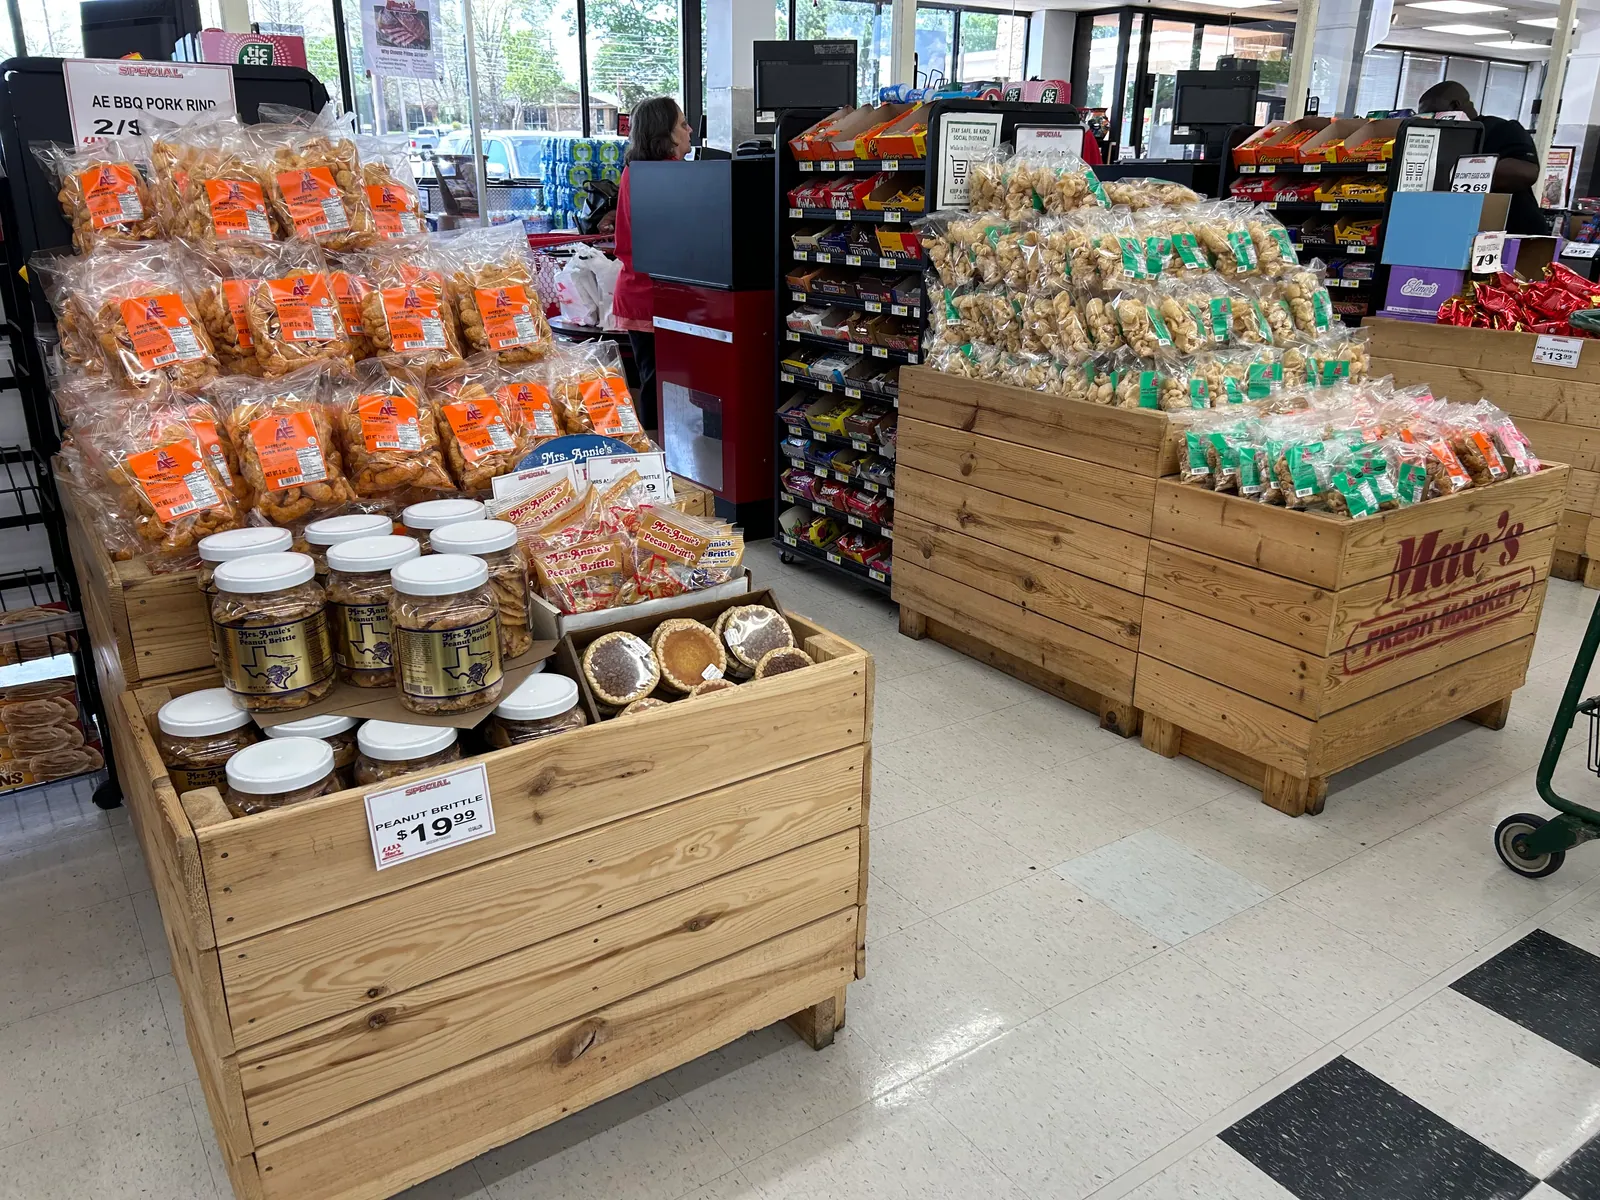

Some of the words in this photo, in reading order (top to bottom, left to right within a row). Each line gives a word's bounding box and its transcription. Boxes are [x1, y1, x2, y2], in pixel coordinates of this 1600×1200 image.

[247, 46, 268, 57] tic
[242, 56, 267, 65] tac
[119, 66, 183, 78] SPECIAL
[1009, 88, 1019, 97] tic
[1046, 88, 1056, 97] tic
[93, 95, 110, 108] AE
[114, 96, 143, 109] BBQ
[146, 98, 183, 111] PORK
[831, 196, 850, 208] KitKat
[1274, 191, 1298, 202] KitKat
[1402, 279, 1437, 294] Elmer's
[404, 297, 422, 309] AE
[496, 295, 512, 307] AE
[517, 392, 533, 401] AE
[380, 406, 397, 416] AE
[467, 409, 483, 421] AE
[276, 426, 296, 441] AE
[542, 452, 568, 466] Mrs.
[572, 441, 612, 461] Annie's
[157, 457, 178, 471] AE
[518, 469, 550, 481] SPECIAL
[510, 504, 531, 522] Mrs.
[529, 486, 563, 511] Annie's
[652, 520, 672, 534] Mrs.
[670, 529, 700, 546] Annie's
[644, 533, 668, 549] Pecan
[668, 544, 696, 560] Brittle
[706, 540, 731, 549] nnie's
[546, 552, 570, 564] Mrs.
[571, 545, 610, 559] Annie's
[1383, 510, 1524, 604] Mac's
[546, 567, 578, 577] Pecan
[580, 560, 615, 572] Brittle
[348, 608, 366, 616] Mrs.
[1365, 612, 1435, 656] FRESH
[1440, 581, 1521, 630] MARKET
[238, 630, 258, 639] Mrs.
[258, 627, 291, 639] Annie's
[442, 632, 463, 641] Mrs.
[463, 624, 489, 638] Annie's
[268, 635, 296, 645] Brittle
[443, 639, 471, 647] Peanut
[472, 631, 491, 642] Brittle
[405, 779, 451, 796] SPECIAL
[375, 810, 428, 832] PEANUT
[431, 794, 483, 815] BRITTLE
